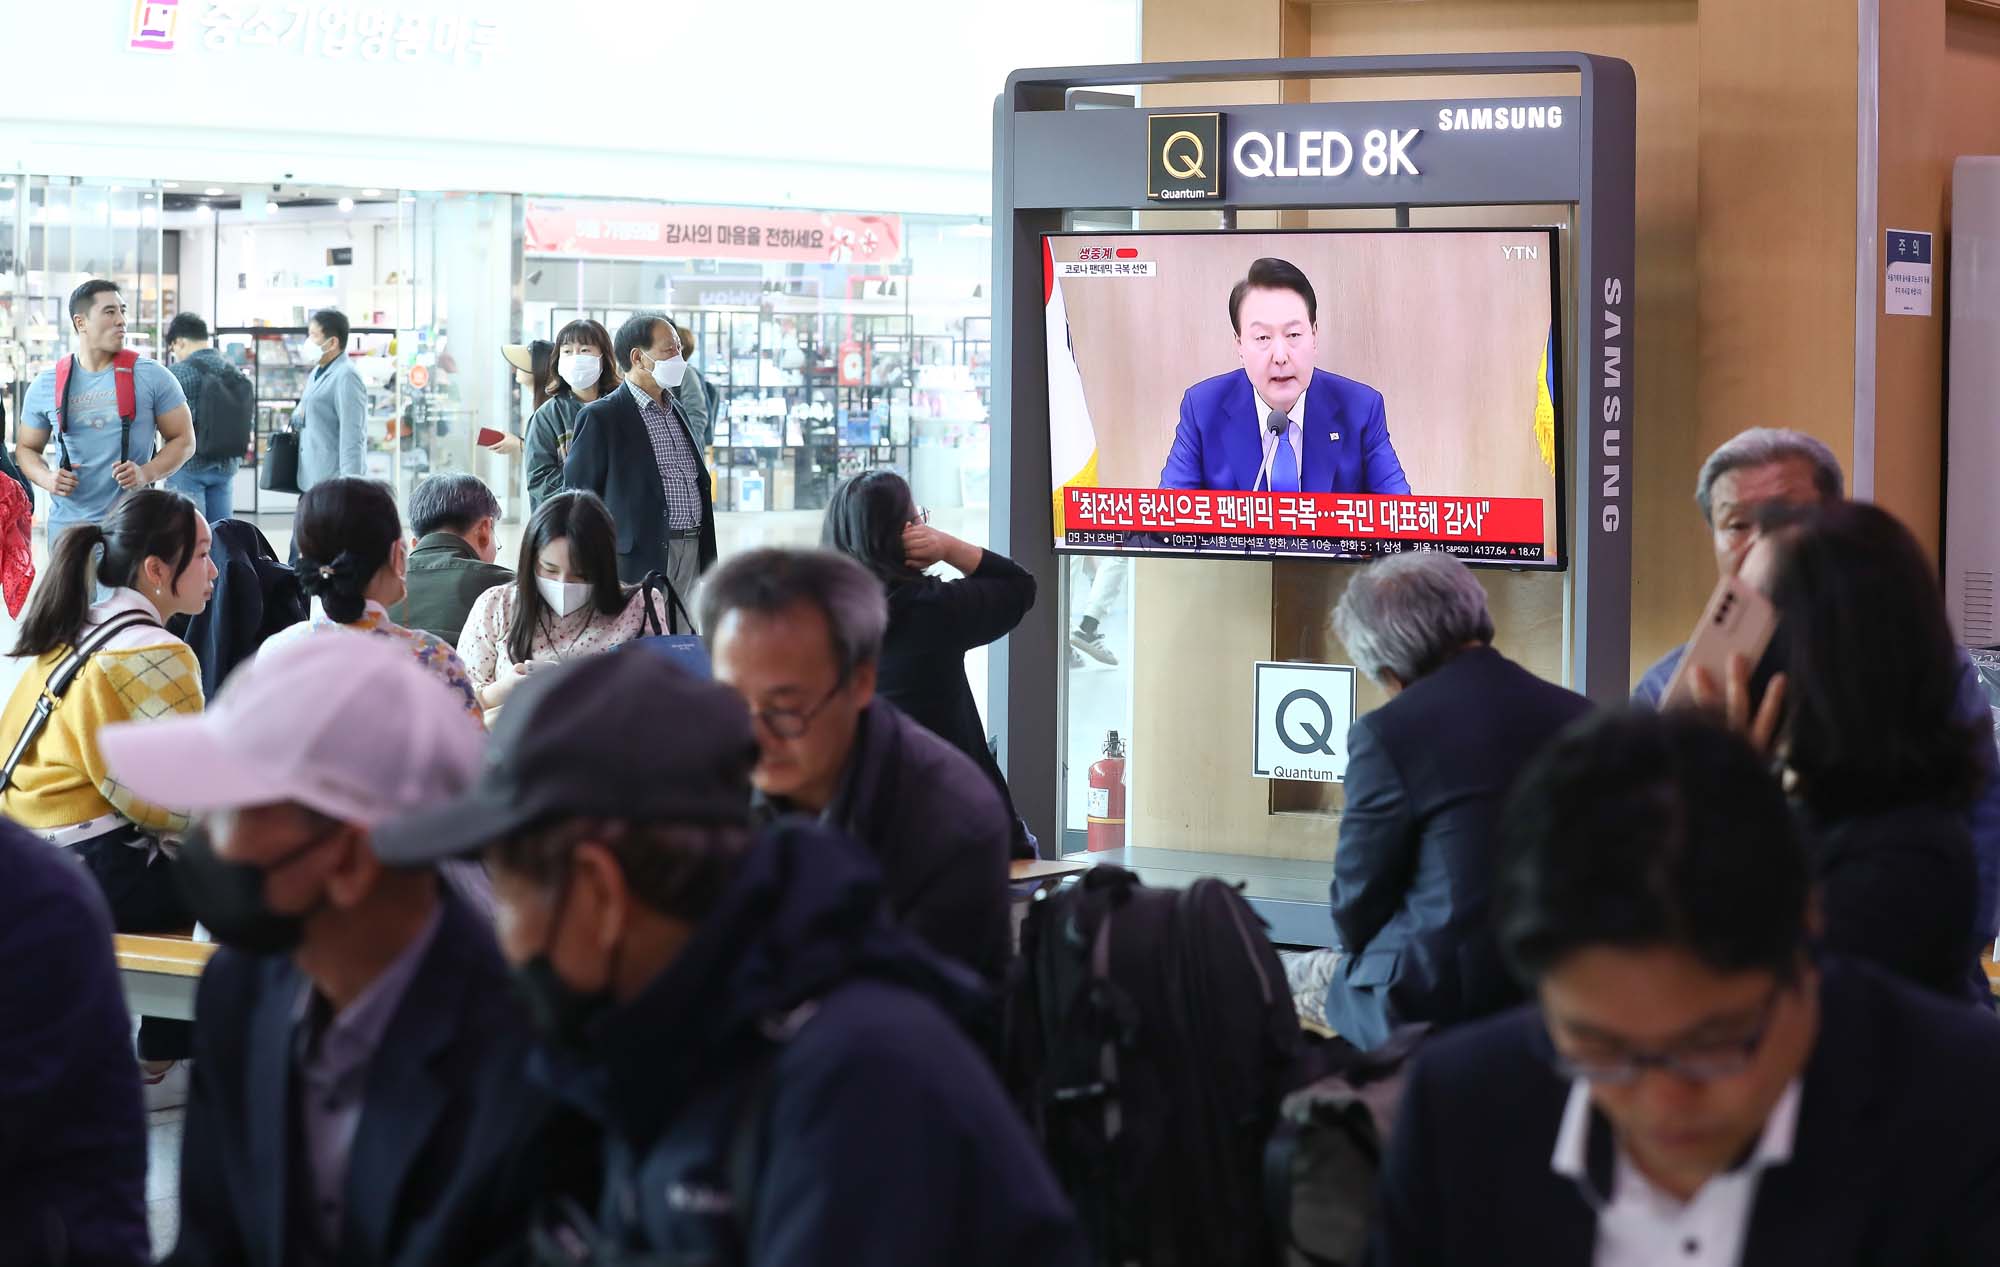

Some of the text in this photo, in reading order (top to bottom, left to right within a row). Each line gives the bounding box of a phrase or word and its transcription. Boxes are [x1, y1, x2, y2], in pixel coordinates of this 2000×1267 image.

[1438, 106, 1563, 131] SAMSUNG
[1162, 130, 1207, 179] Q
[1233, 128, 1421, 177] QLED 8K
[1161, 189, 1205, 200] Quantum
[666, 224, 712, 244] 감사의
[716, 225, 760, 246] 마음을
[766, 228, 825, 249] 전하세요
[1079, 247, 1113, 260] 생중계
[1501, 246, 1539, 260] YTN
[1065, 263, 1147, 274] 코로나 팬데믹 극복 선언
[1602, 277, 1622, 532] SAMSUNG
[1072, 491, 1134, 525] "최전선
[1138, 494, 1213, 527] 헌신으로
[1217, 495, 1274, 530] 팬데믹
[1380, 500, 1438, 535] 대표해
[1443, 501, 1490, 536] 감사"
[1172, 535, 1197, 547] [야구]
[1198, 536, 1227, 547] '노시환
[1268, 538, 1289, 549] 한화,
[1291, 538, 1309, 550] 시즌
[1360, 541, 1367, 551] 5
[1375, 541, 1380, 551] 1
[1383, 541, 1401, 553] 삼성
[1446, 545, 1541, 556] S&P500 4137.64 18.47
[1275, 689, 1336, 755] Q
[1274, 766, 1333, 780] Quantum
